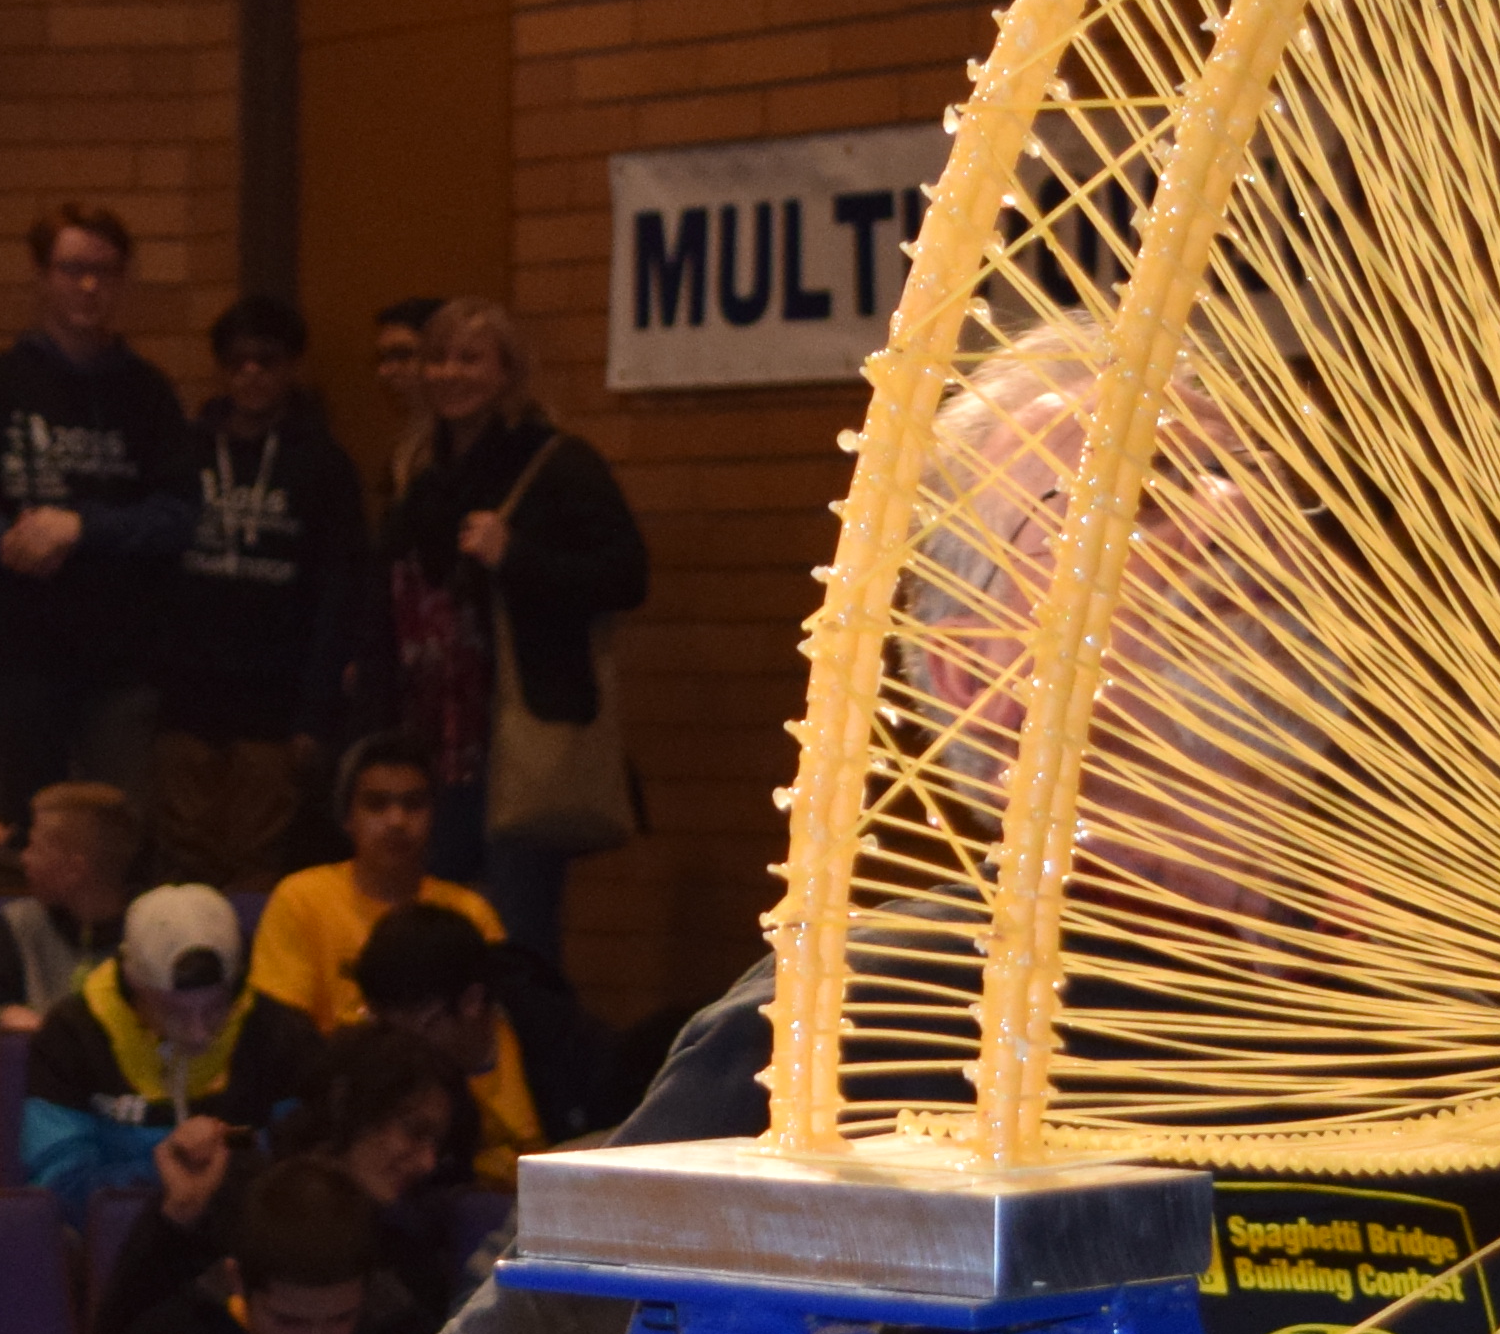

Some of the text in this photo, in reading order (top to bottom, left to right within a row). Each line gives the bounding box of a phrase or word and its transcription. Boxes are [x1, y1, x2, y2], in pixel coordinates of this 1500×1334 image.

[1227, 1214, 1459, 1264] Spaghetti Bridge
[1233, 1256, 1354, 1302] Building
